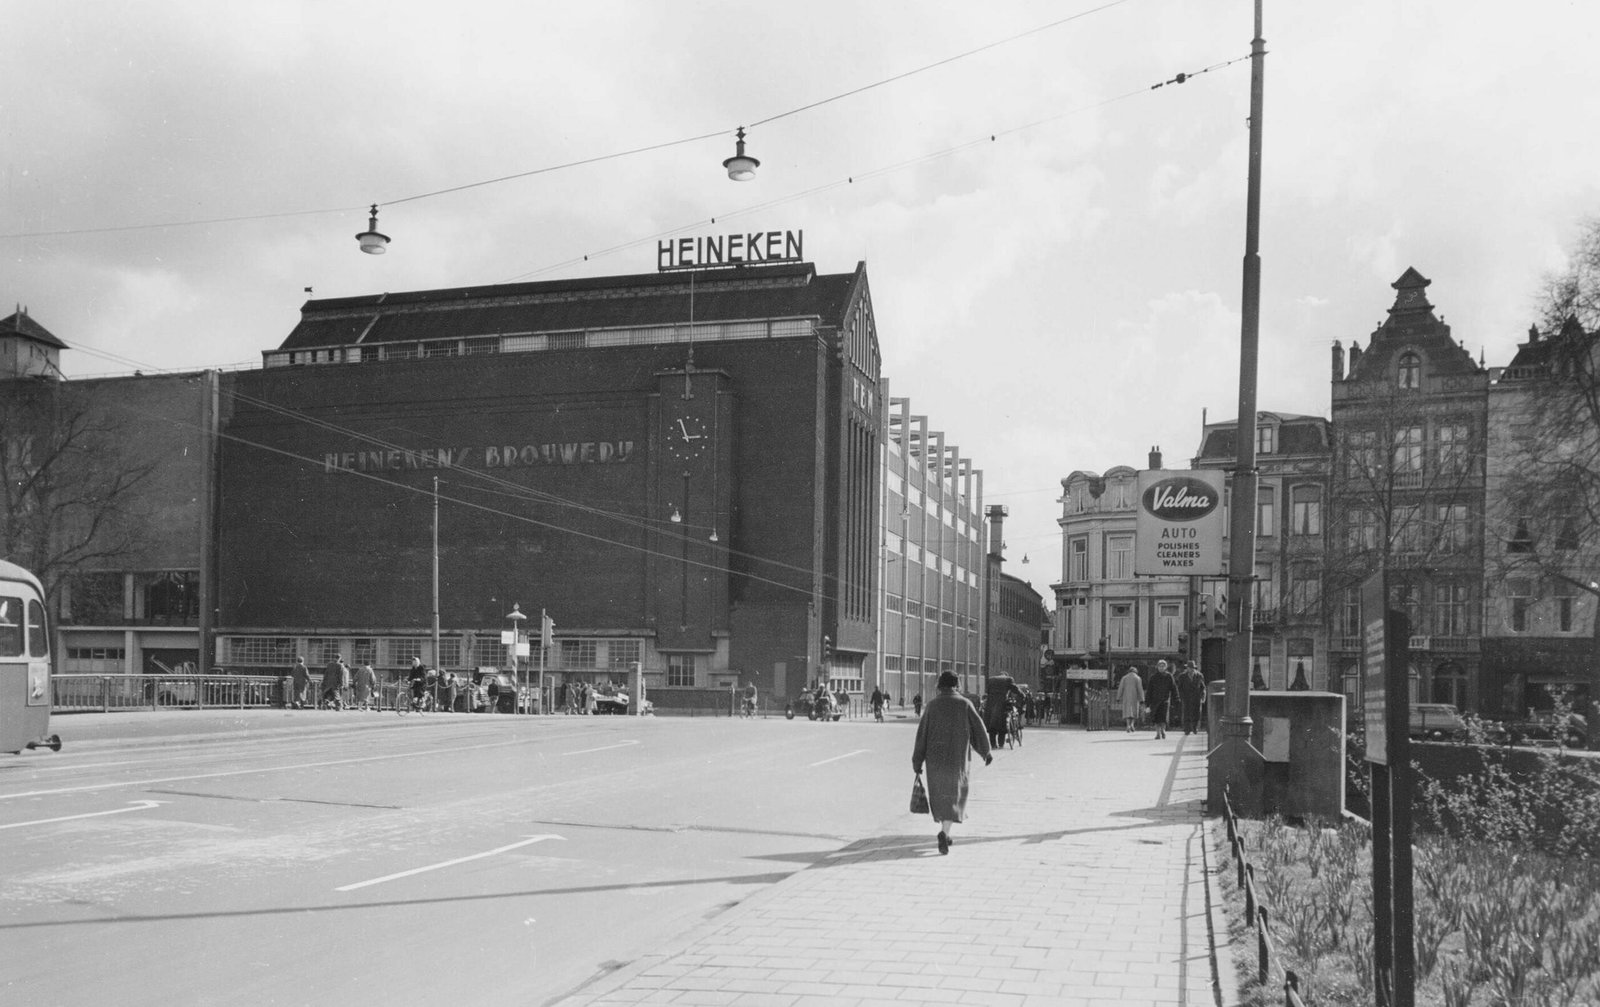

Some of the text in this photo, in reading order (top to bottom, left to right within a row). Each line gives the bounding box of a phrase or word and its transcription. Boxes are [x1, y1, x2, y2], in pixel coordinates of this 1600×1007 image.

[658, 229, 803, 268] HEINEKEN
[1153, 485, 1210, 511] Valma
[1161, 528, 1197, 539] AUTO
[1157, 542, 1200, 550] POLISHES
[1156, 551, 1201, 559] CLEANERS
[1162, 559, 1195, 567] WAXES
